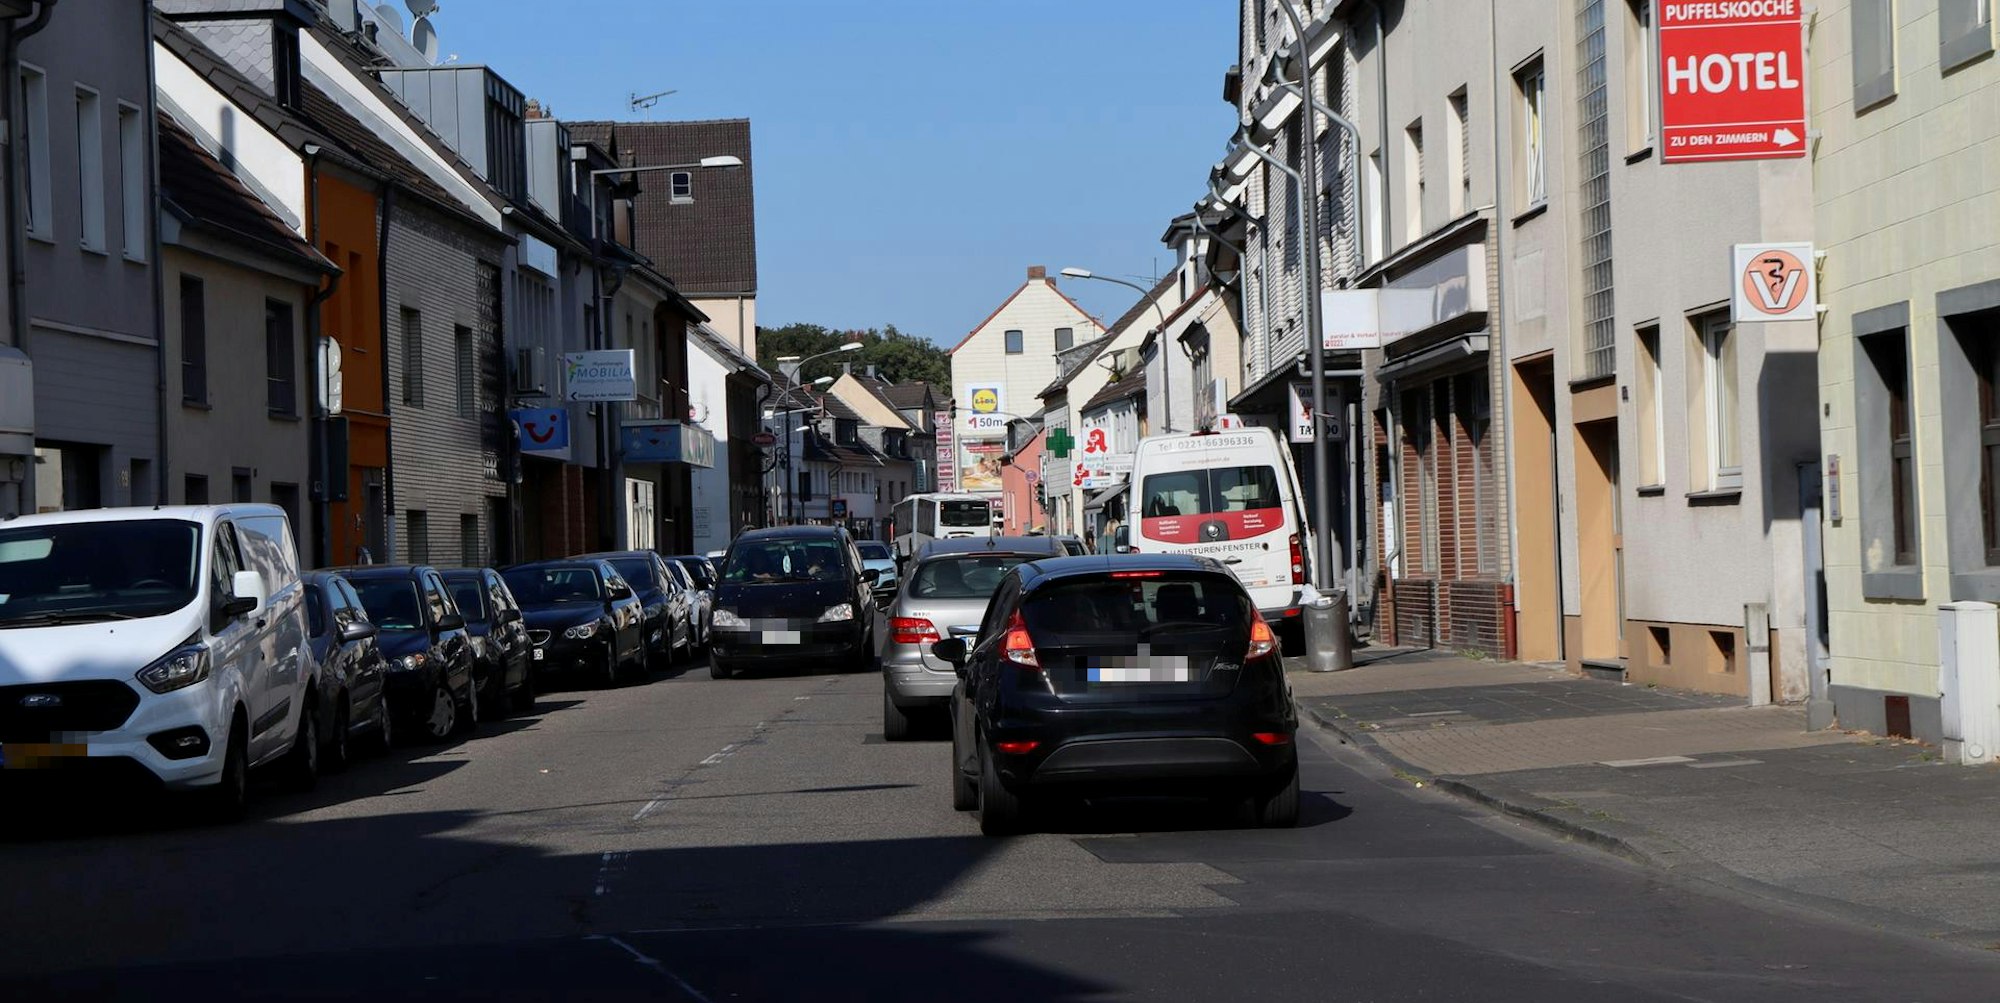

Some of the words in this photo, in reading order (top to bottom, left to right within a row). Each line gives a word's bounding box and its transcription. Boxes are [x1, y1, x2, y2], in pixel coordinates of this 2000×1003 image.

[1667, 50, 1799, 95] HOTEL
[1670, 136, 1686, 147] ZU
[1689, 135, 1713, 146] DEN
[1715, 132, 1768, 145] ZIMMERN
[577, 367, 632, 378] MOBILIA
[1299, 424, 1339, 436] TAO
